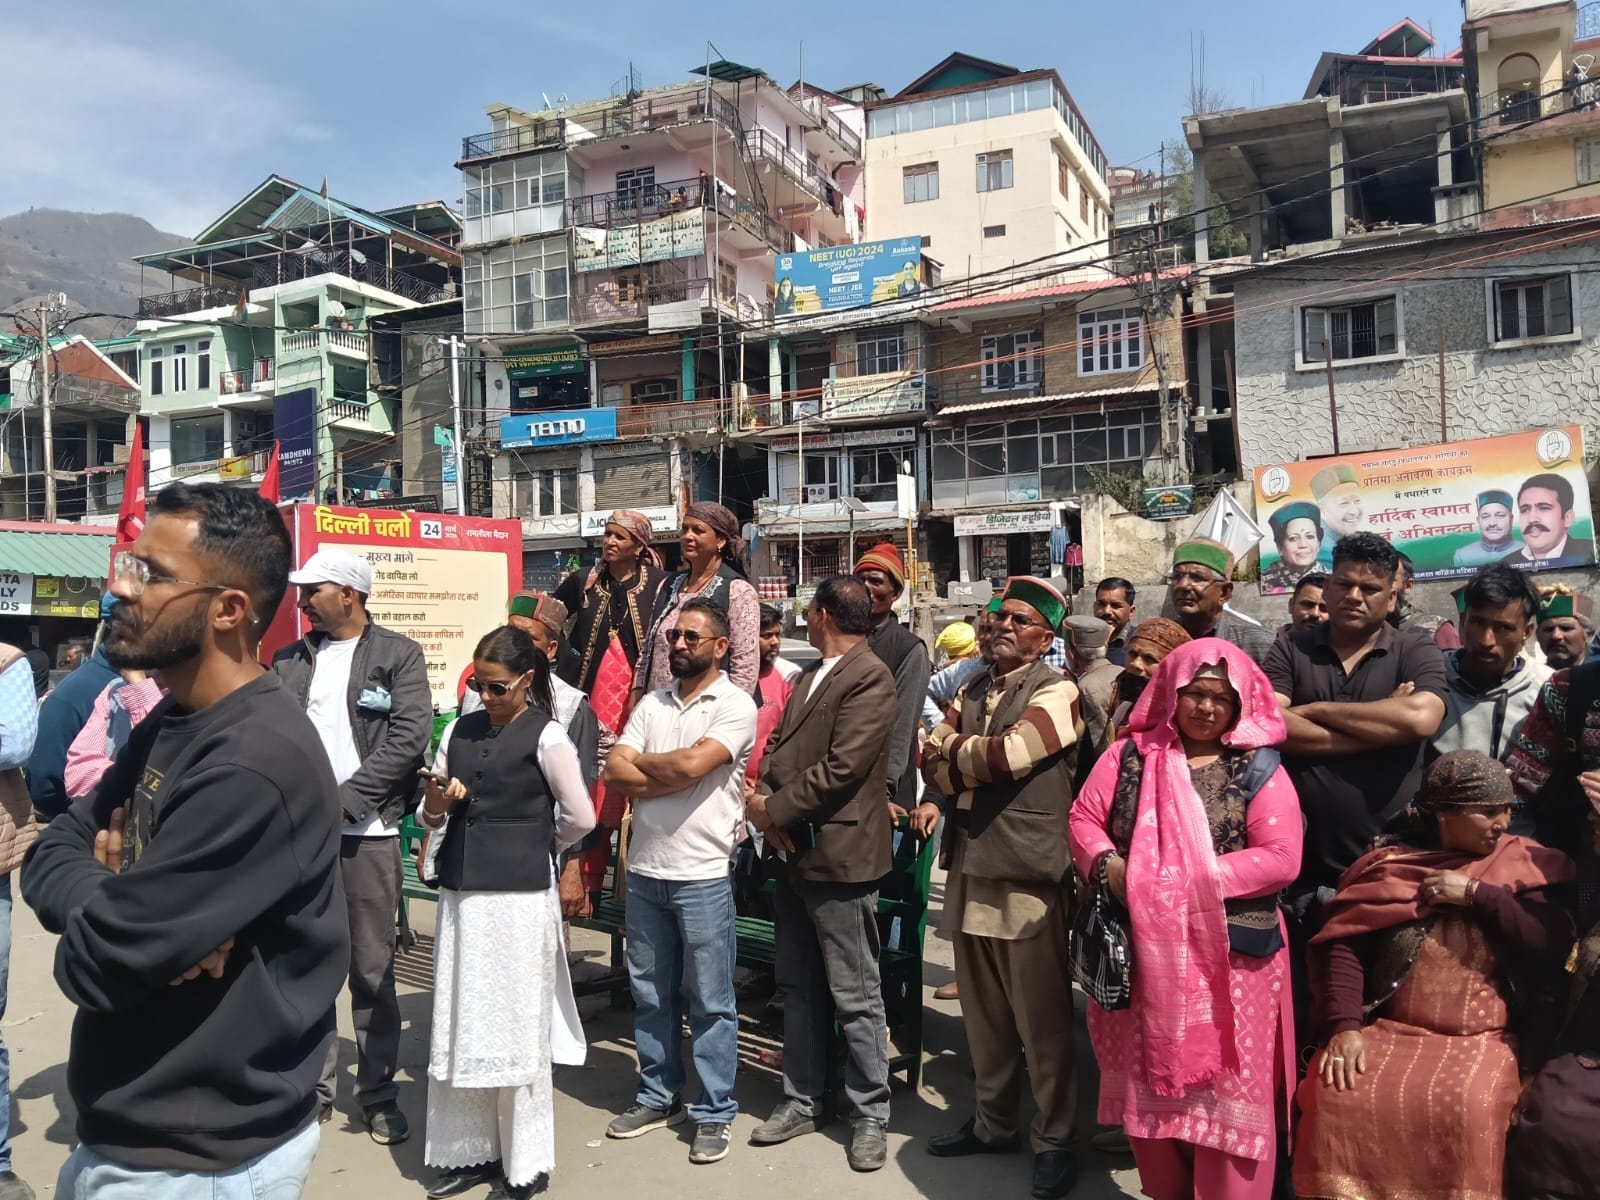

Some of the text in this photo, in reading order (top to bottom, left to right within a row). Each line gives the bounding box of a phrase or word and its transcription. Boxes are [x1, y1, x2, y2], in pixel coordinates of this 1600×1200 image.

[809, 245, 884, 263] NEET (UG) 2024
[527, 418, 586, 438] TECNO
[1395, 468, 1434, 482] अनावरण
[1404, 488, 1429, 498] पधारने
[1432, 487, 1443, 496] पर
[1368, 503, 1473, 526] हार्दिक स्वागत
[313, 506, 412, 538] दिल्ली चलो
[424, 523, 440, 537] 24
[1399, 523, 1475, 540] अभिनन्दन
[366, 551, 391, 566] मुख्य
[409, 571, 419, 580] लो
[466, 592, 479, 601] करो
[381, 611, 391, 621] को
[392, 613, 411, 622] बहाल
[412, 611, 426, 621] करो
[408, 629, 464, 639] विधेयक वापिस लो
[429, 642, 443, 651] करो
[439, 661, 447, 671] दो
